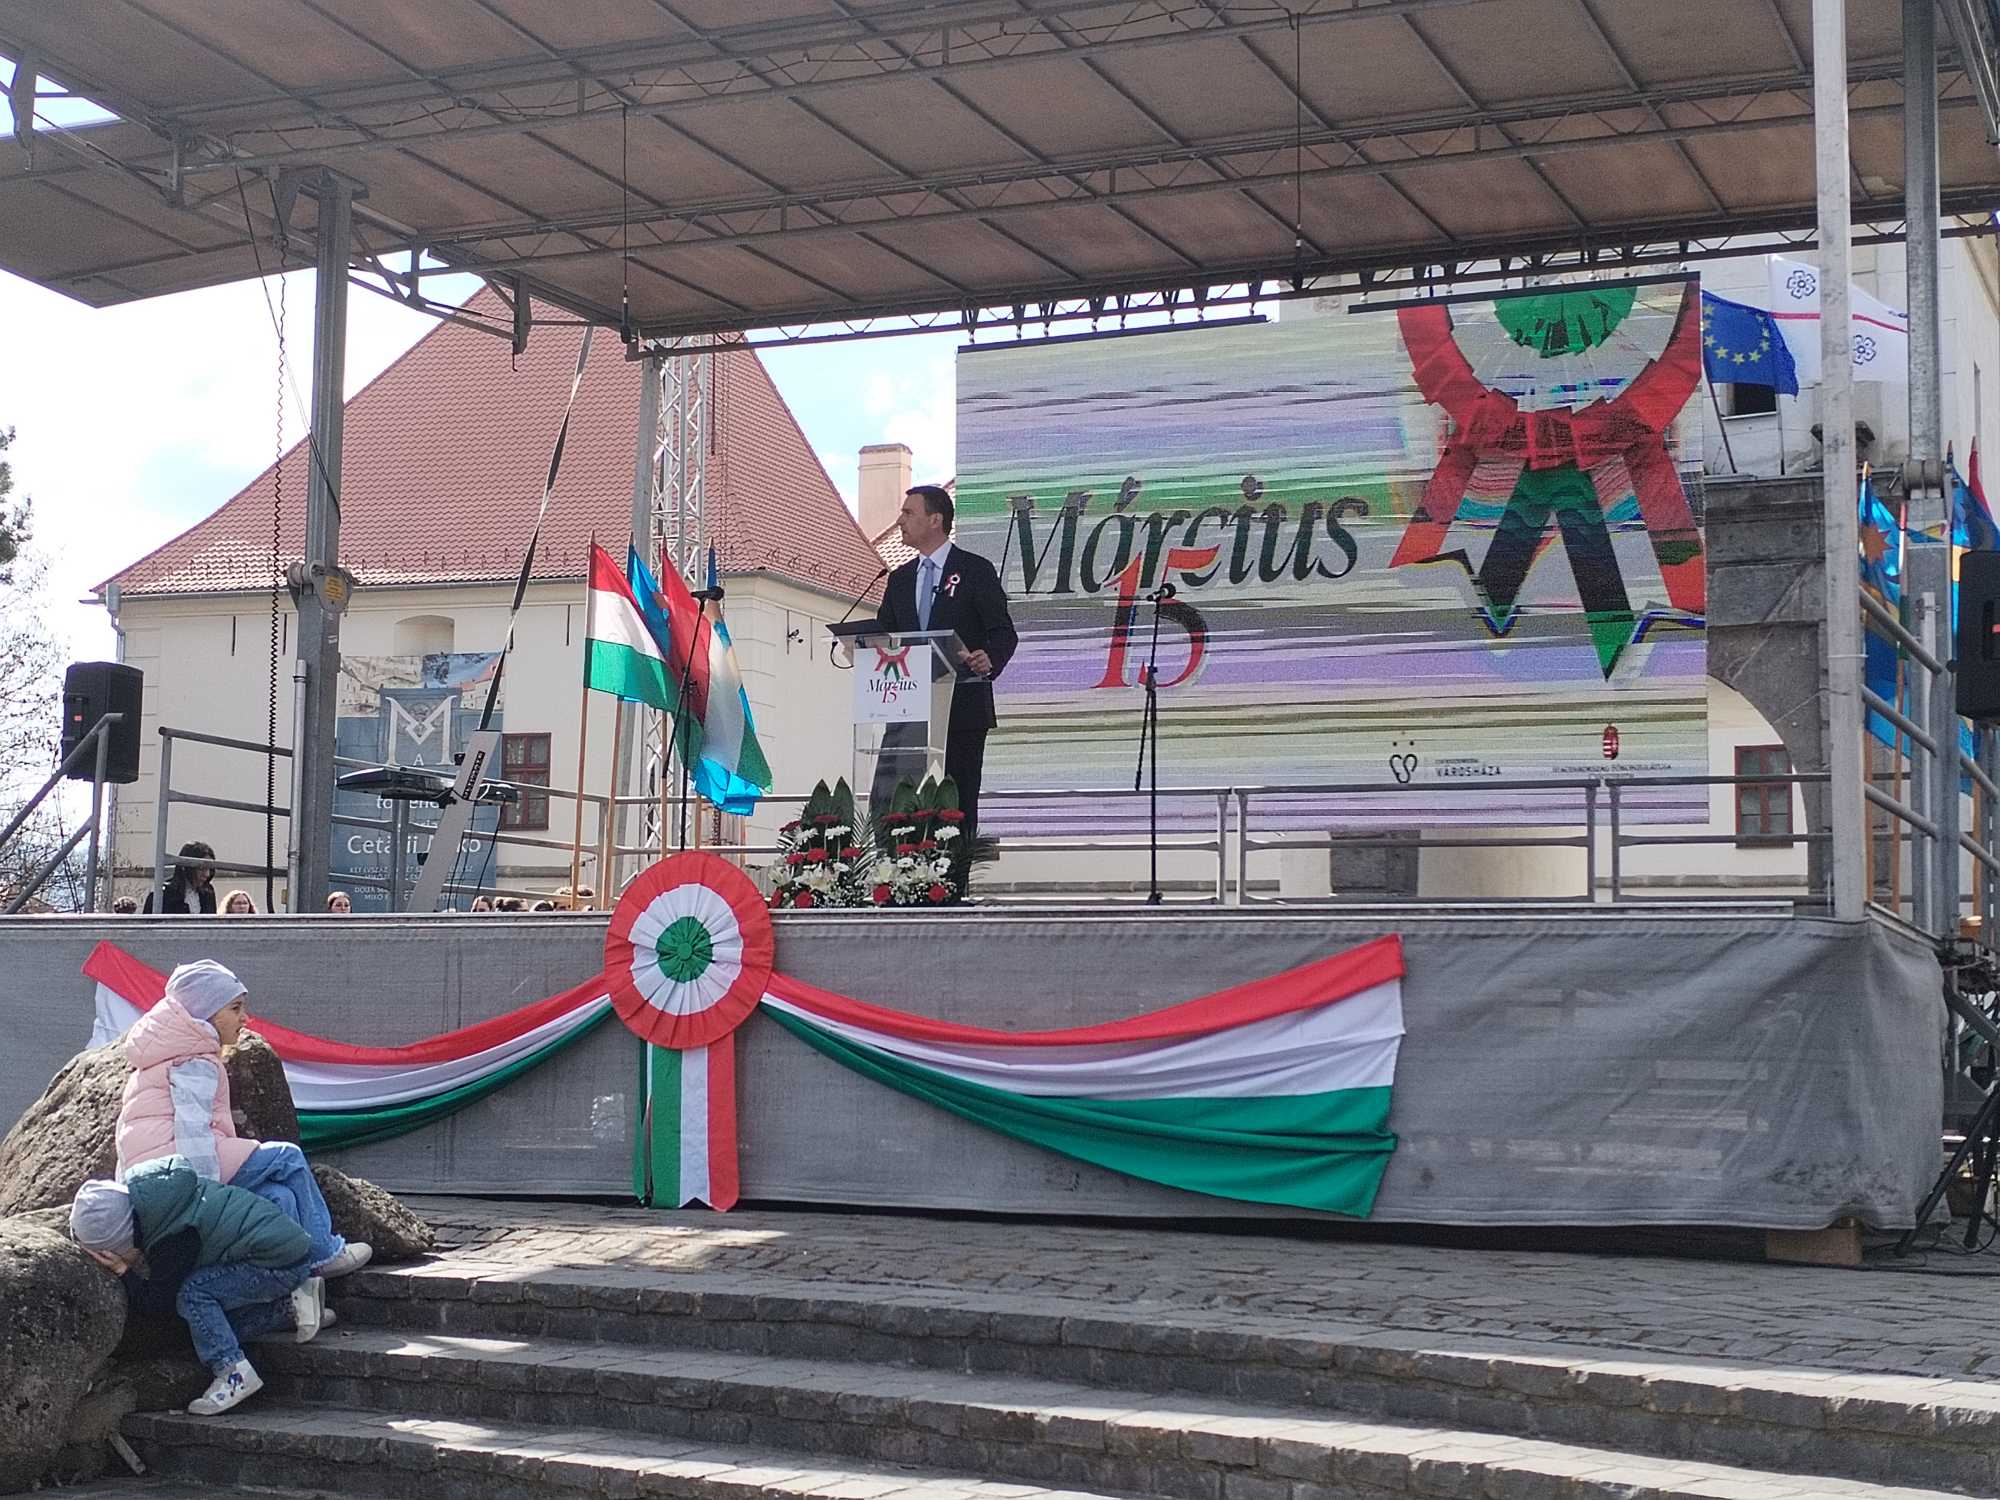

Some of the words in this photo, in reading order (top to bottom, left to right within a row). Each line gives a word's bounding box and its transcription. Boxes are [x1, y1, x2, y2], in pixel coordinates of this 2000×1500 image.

[1000, 475, 1369, 594] Március
[1090, 543, 1220, 688] 15
[866, 676, 918, 693] Március
[882, 683, 898, 704] 15
[413, 753, 424, 766] A
